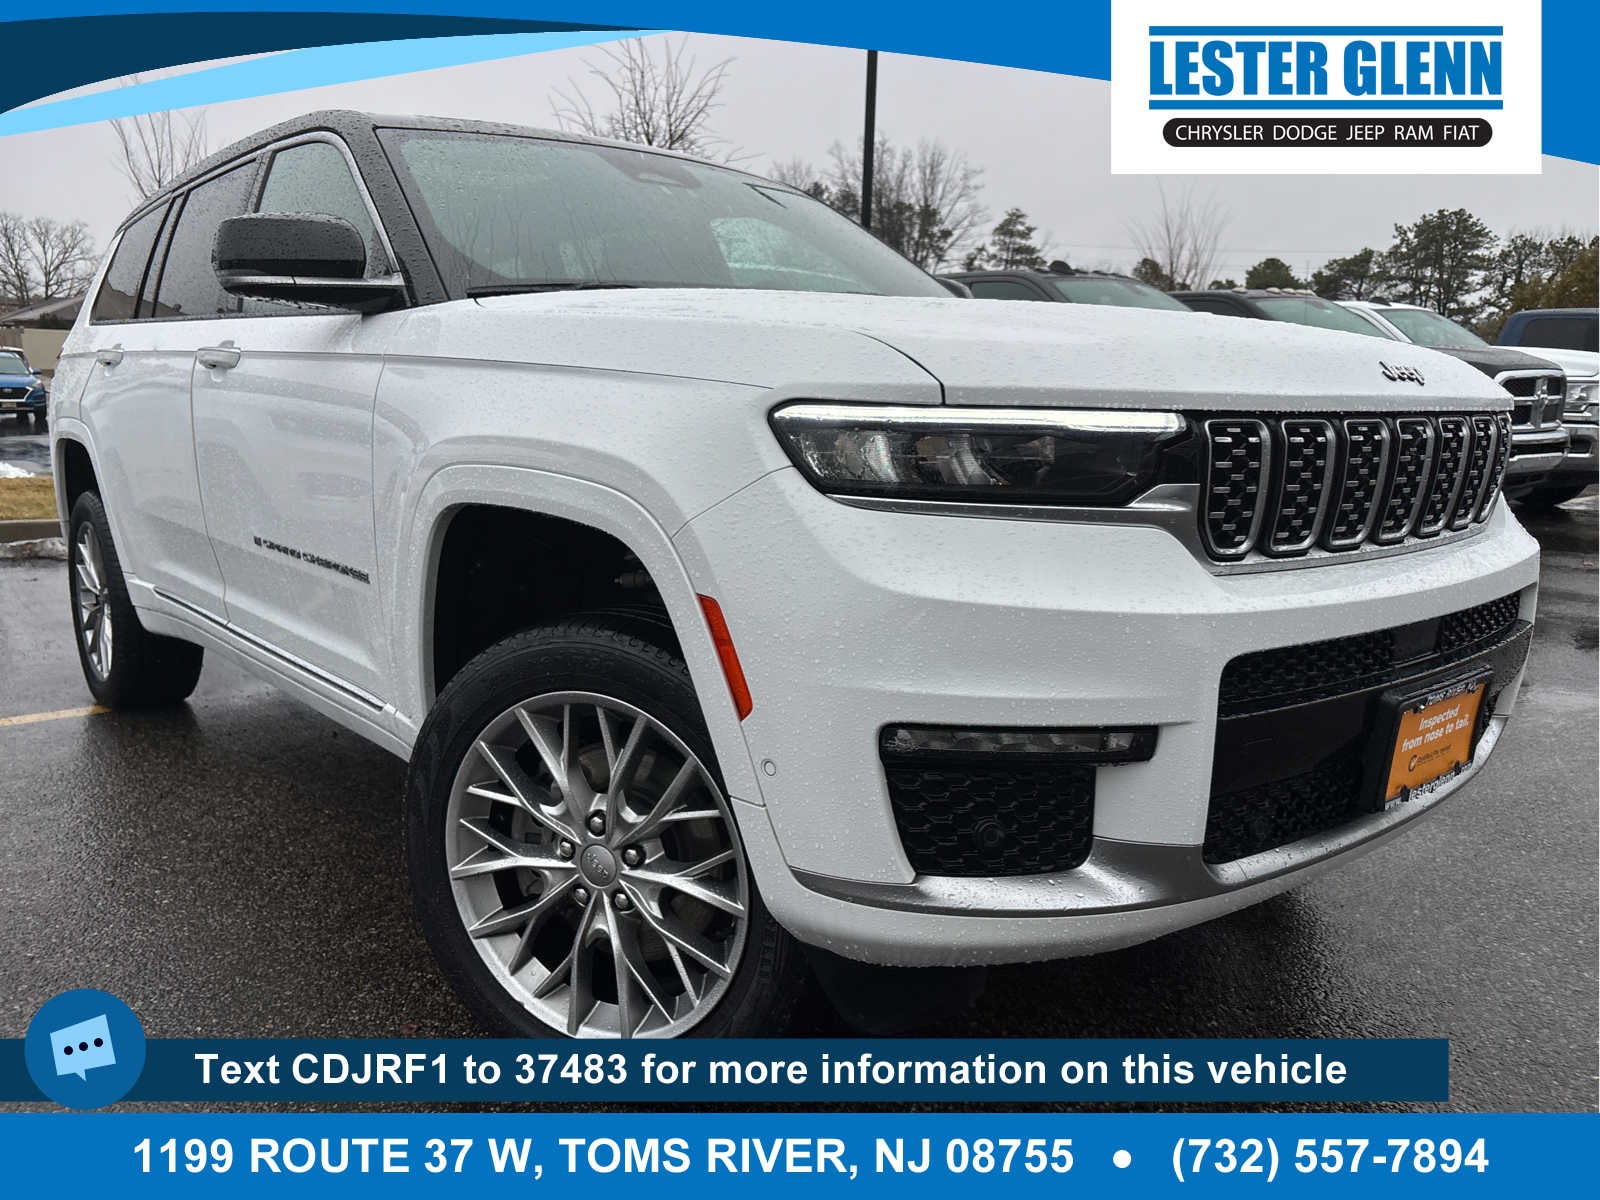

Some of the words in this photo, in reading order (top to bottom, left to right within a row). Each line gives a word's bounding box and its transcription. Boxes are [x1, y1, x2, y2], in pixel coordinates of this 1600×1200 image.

[1379, 361, 1425, 386] Jeep
[1418, 704, 1460, 732] Inspected
[1402, 736, 1423, 753] from
[1424, 728, 1445, 744] nose
[1445, 723, 1455, 735] to
